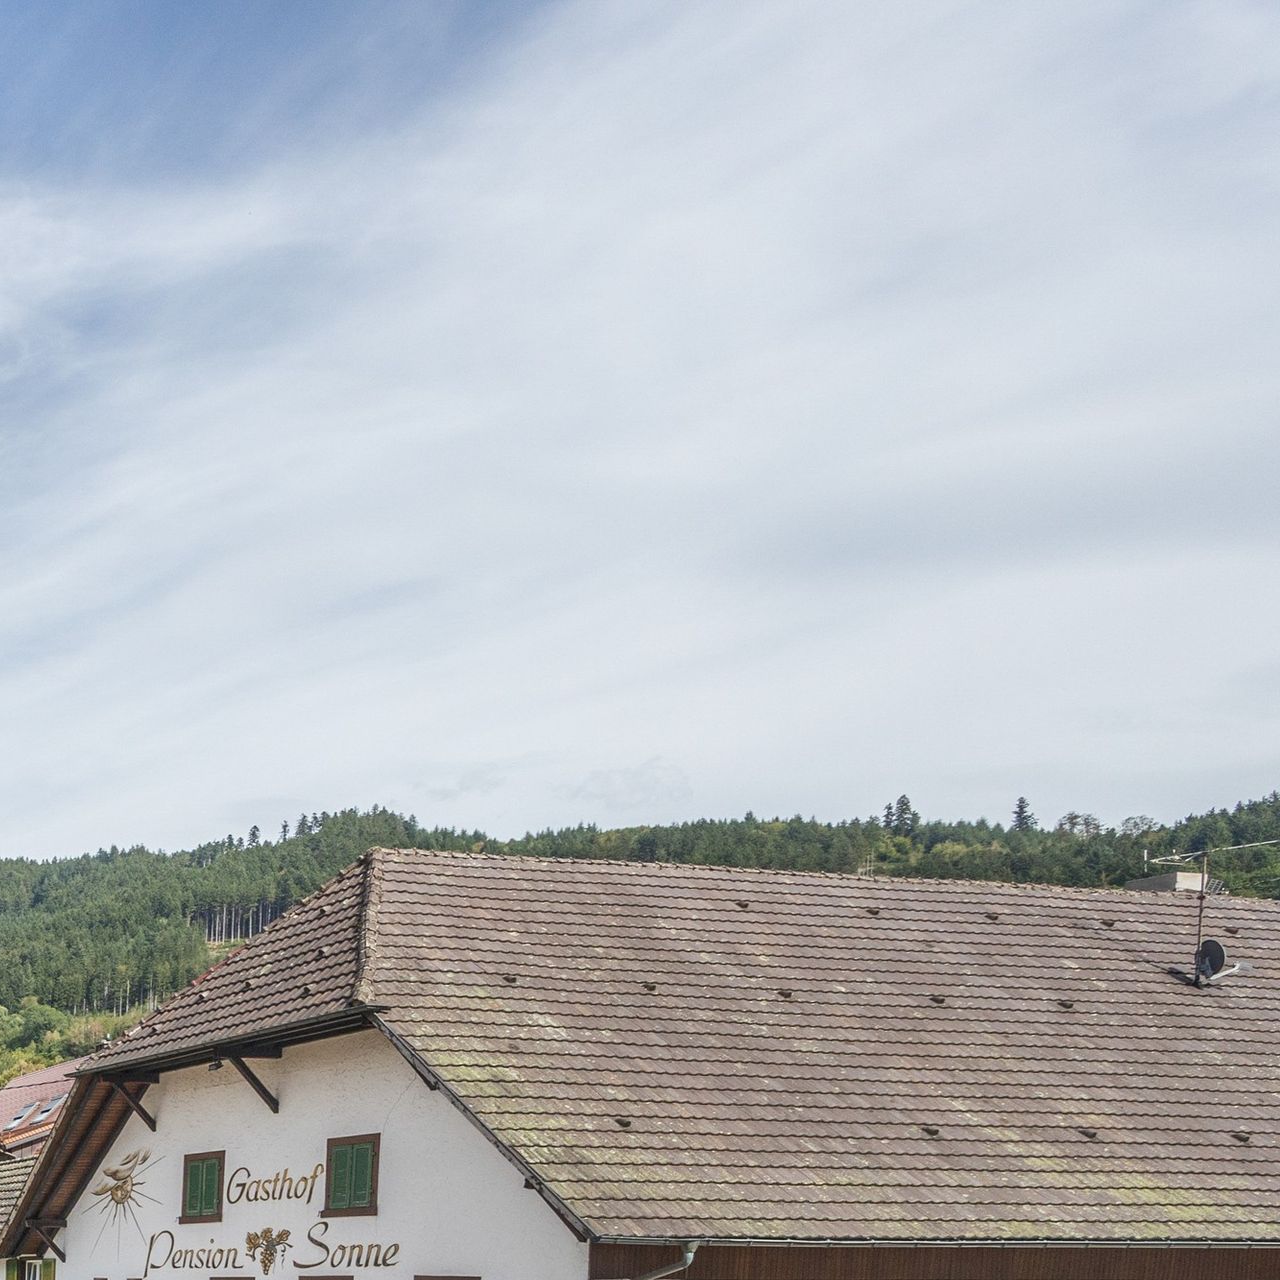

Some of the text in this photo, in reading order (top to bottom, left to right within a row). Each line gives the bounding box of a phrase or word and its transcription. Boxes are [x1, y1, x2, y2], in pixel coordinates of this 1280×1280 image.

[226, 1163, 324, 1204] Gasthof
[143, 1221, 400, 1278] Pension Sonne
